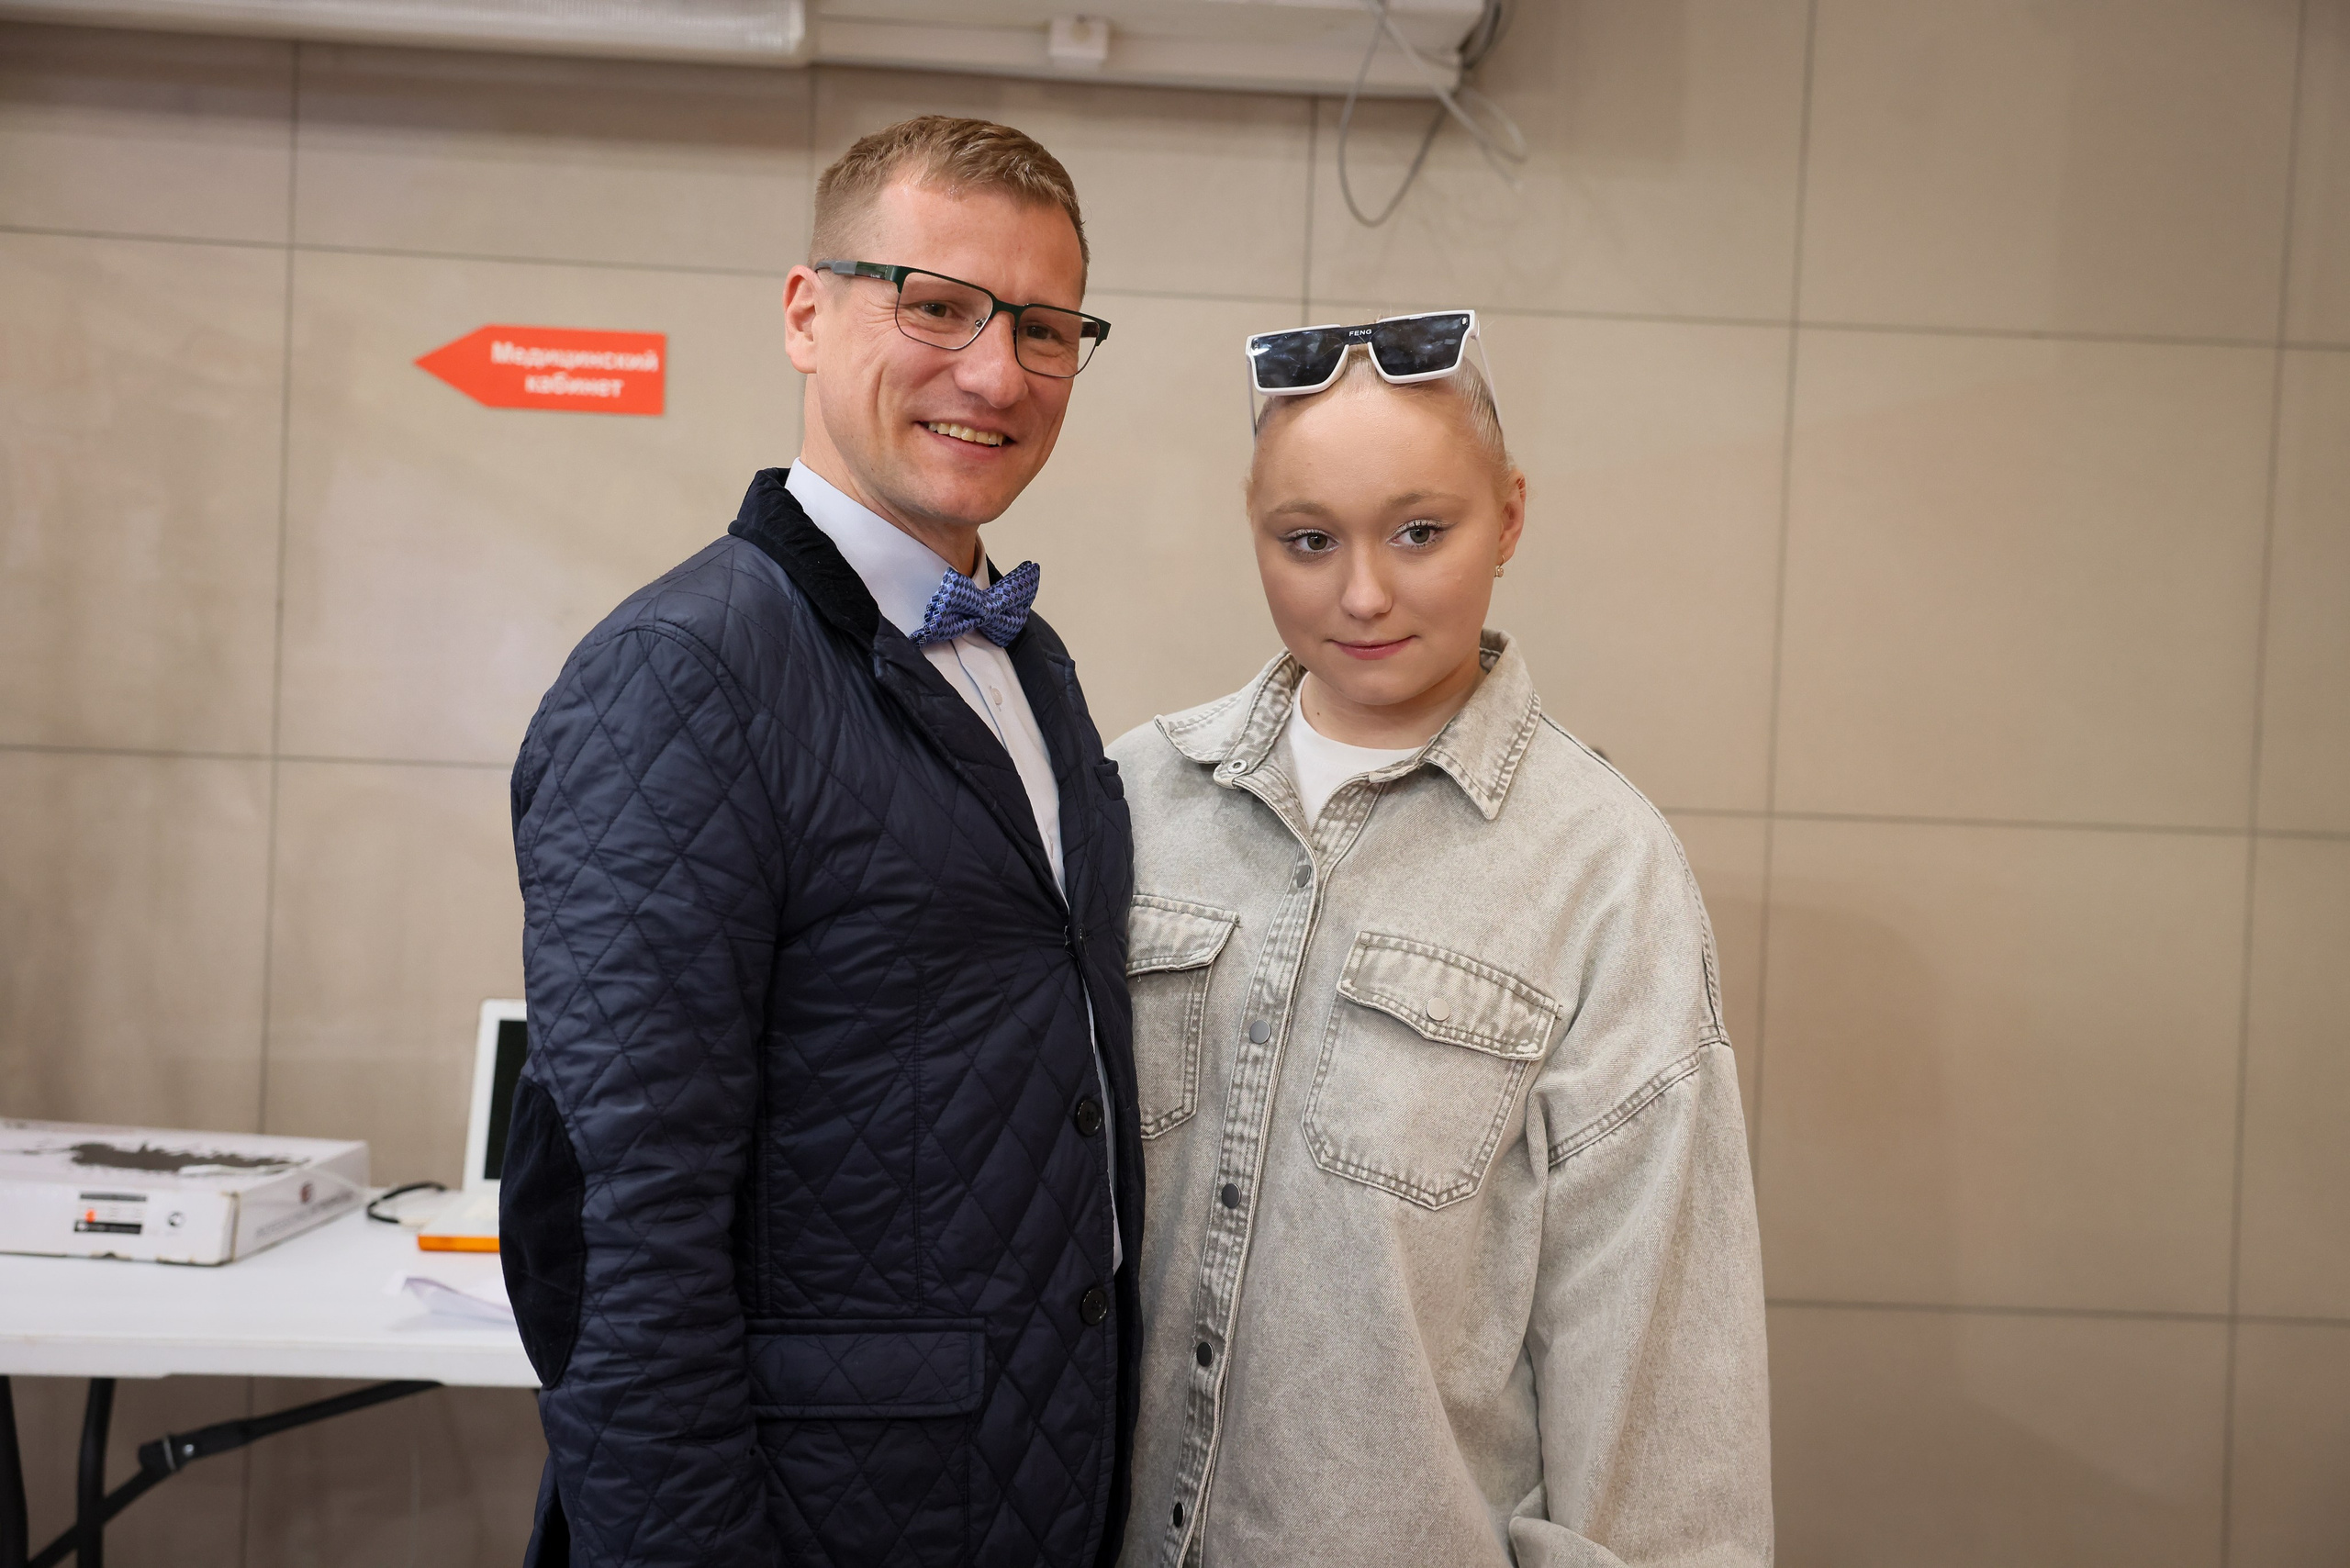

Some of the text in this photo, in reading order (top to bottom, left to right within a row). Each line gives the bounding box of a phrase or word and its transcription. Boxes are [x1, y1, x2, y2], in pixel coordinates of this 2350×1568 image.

[1348, 329, 1372, 337] FENG
[490, 341, 658, 372] Медицинский
[524, 371, 624, 398] кабинет
